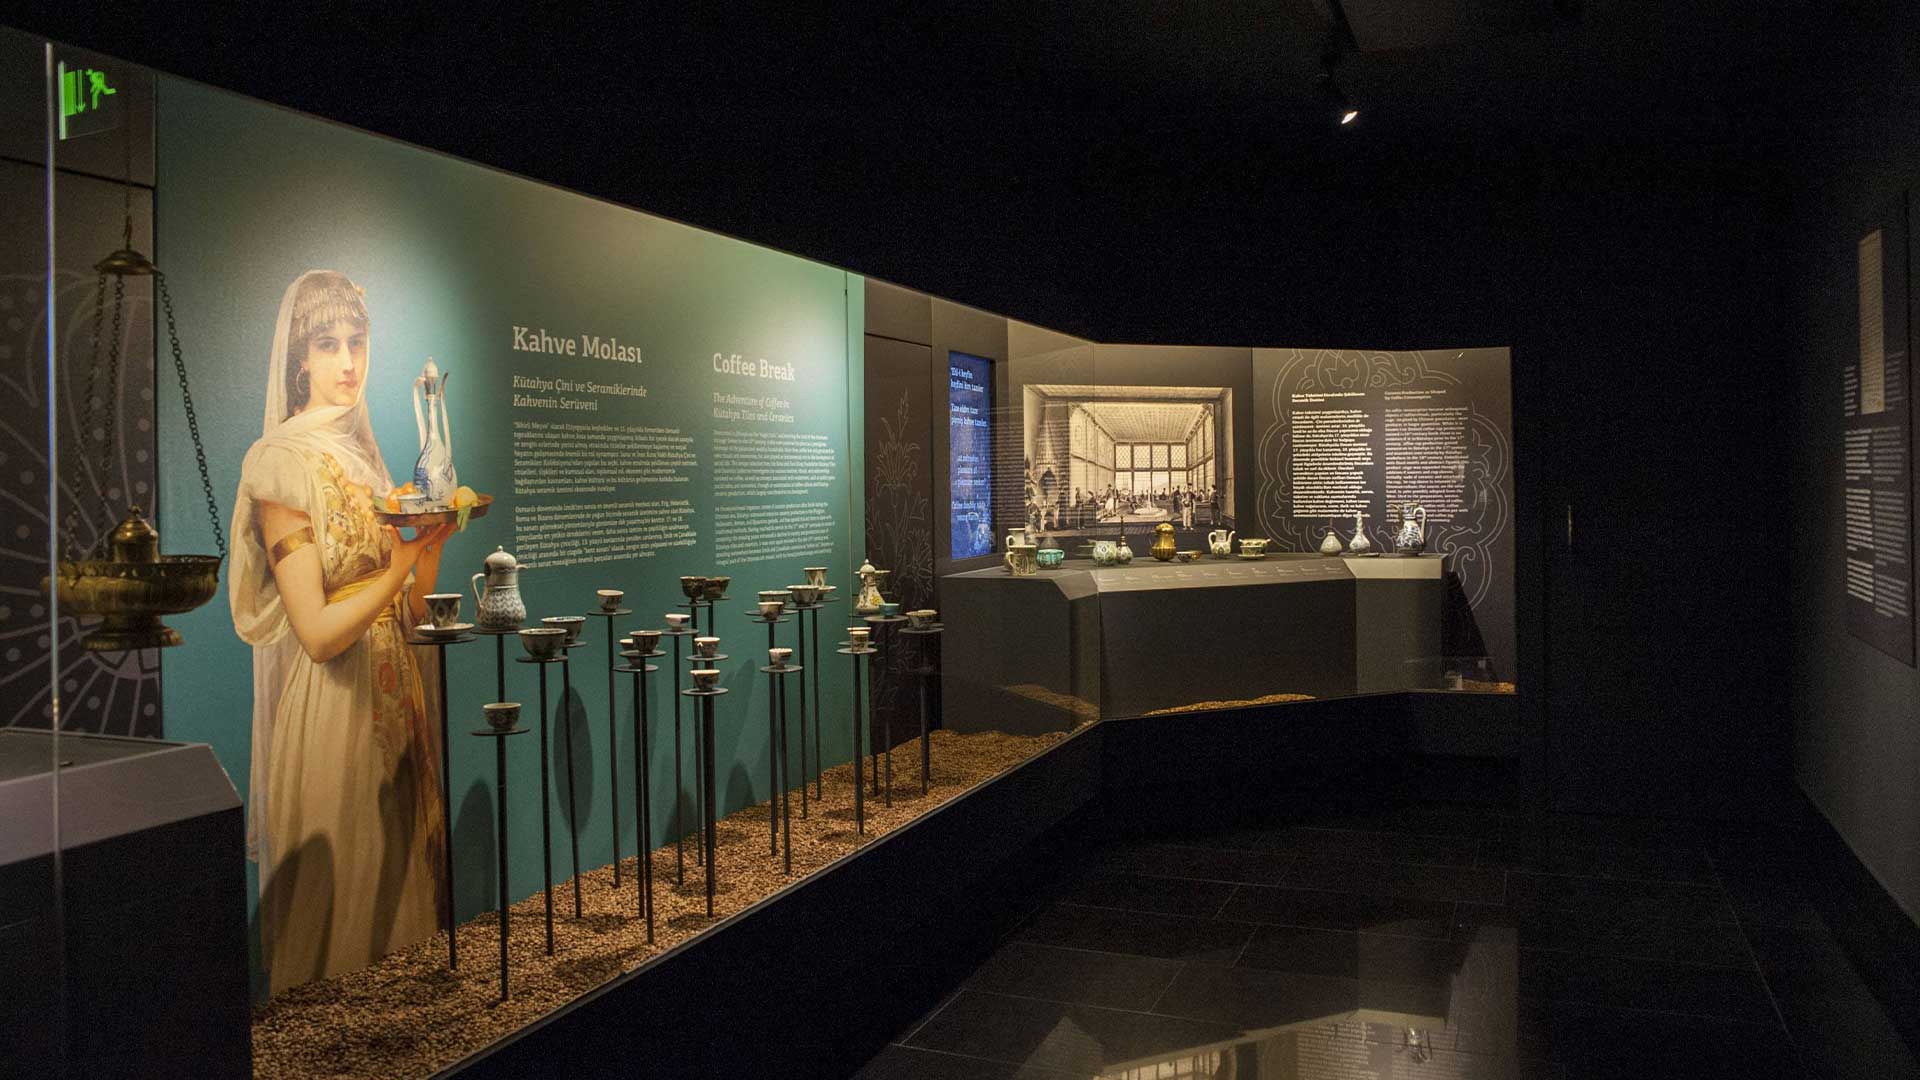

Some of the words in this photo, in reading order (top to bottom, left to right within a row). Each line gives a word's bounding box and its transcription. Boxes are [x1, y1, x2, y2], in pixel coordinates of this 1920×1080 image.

[512, 325, 576, 356] Kahve
[582, 334, 643, 363] Molası
[713, 352, 756, 377] Coffee
[759, 358, 795, 381] Break
[513, 375, 554, 393] Kütahya
[575, 384, 585, 393] ve
[513, 394, 558, 409] Kahvenin
